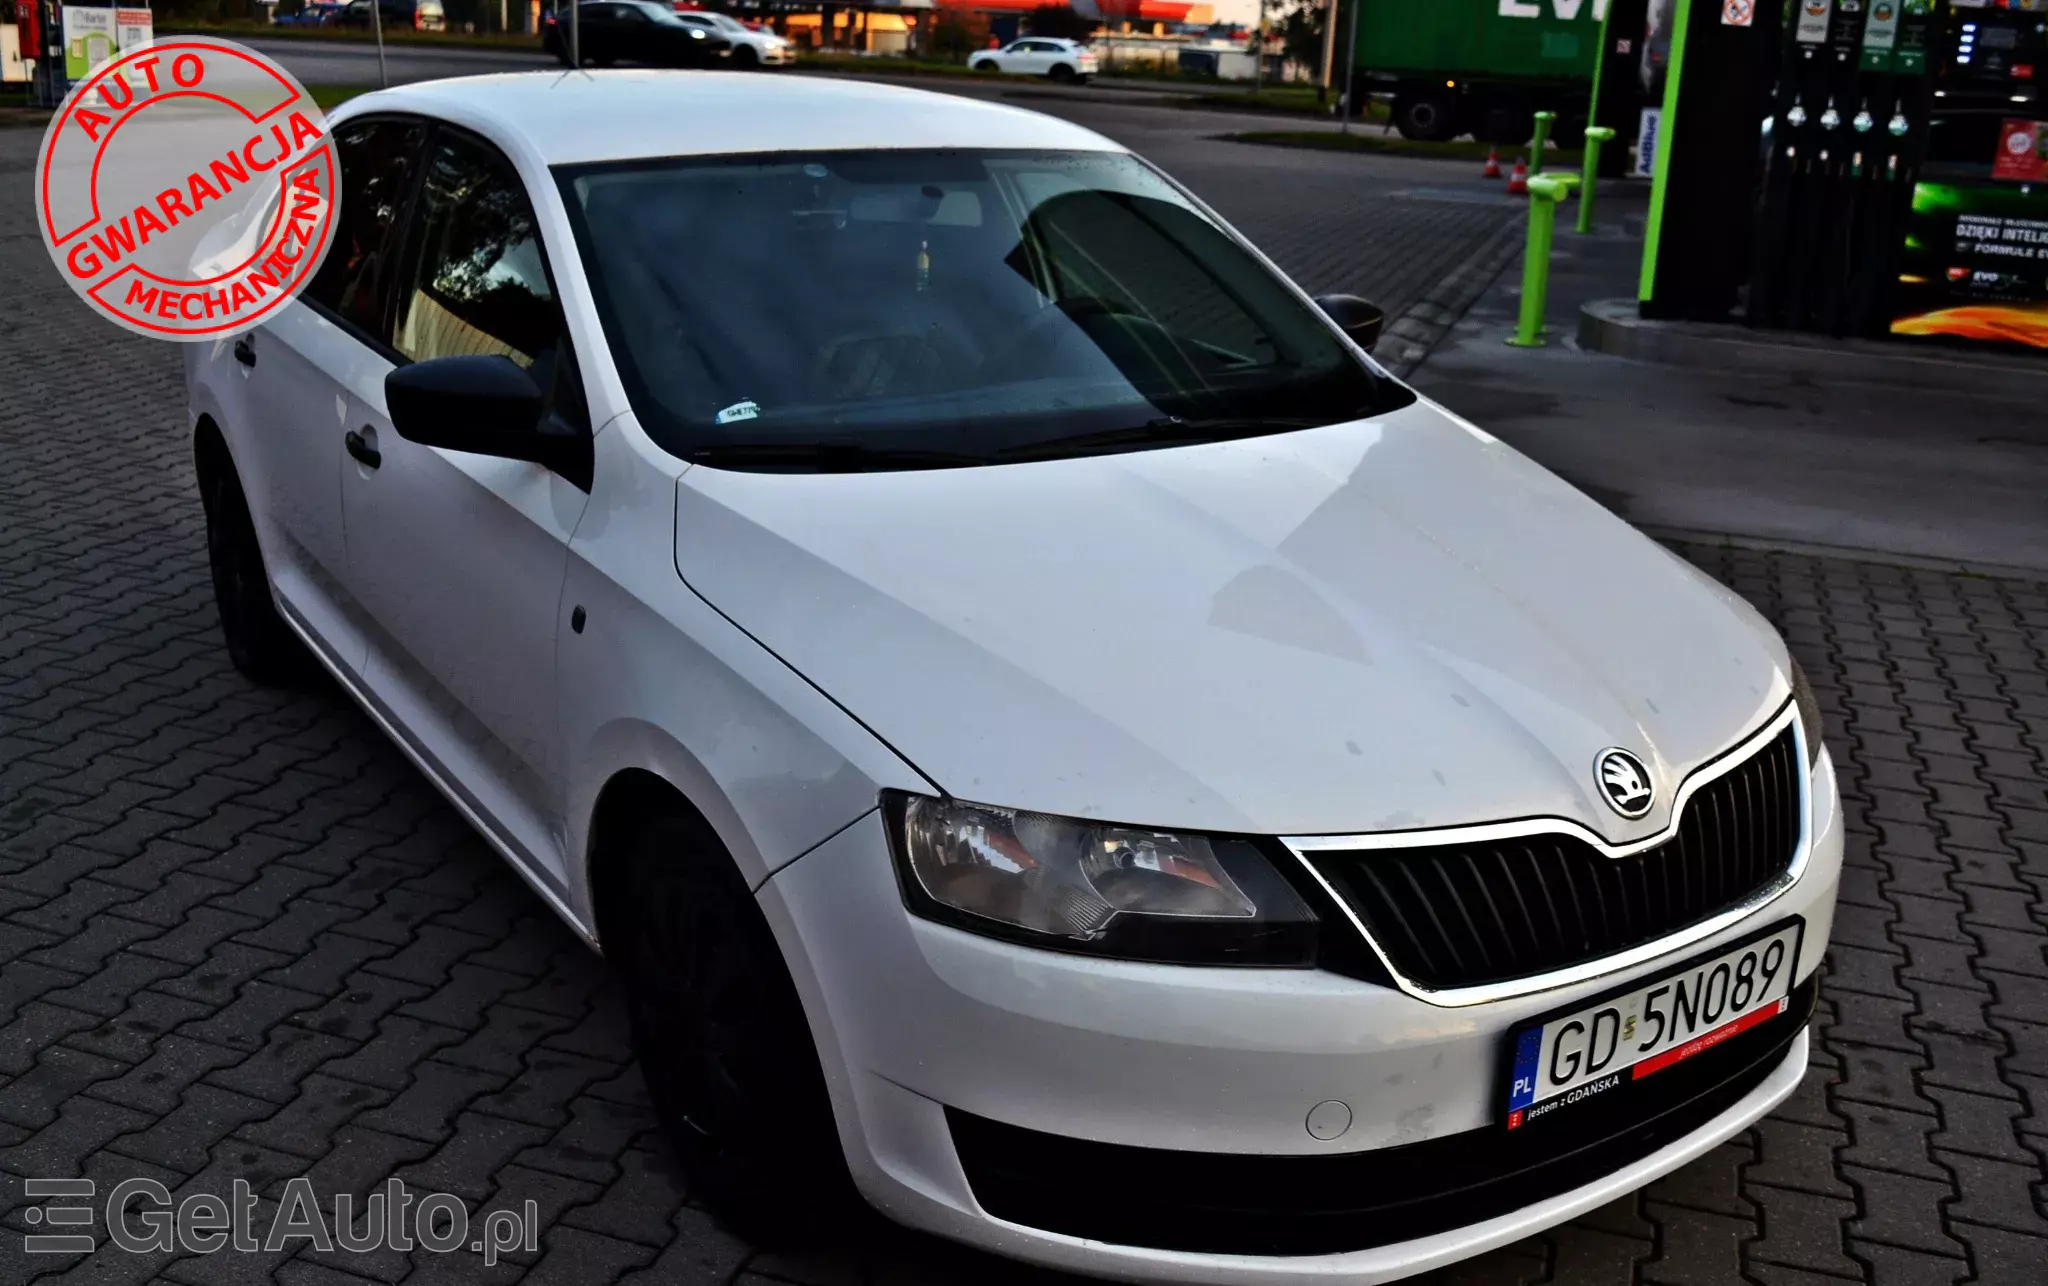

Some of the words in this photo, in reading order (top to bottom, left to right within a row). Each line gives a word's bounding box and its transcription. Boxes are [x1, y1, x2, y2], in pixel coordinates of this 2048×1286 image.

[1550, 1008, 1620, 1086] GD
[1638, 939, 1784, 1052] 5N089
[1513, 1077, 1531, 1098] PL
[1527, 1101, 1558, 1120] jestem
[1560, 1098, 1566, 1106] z
